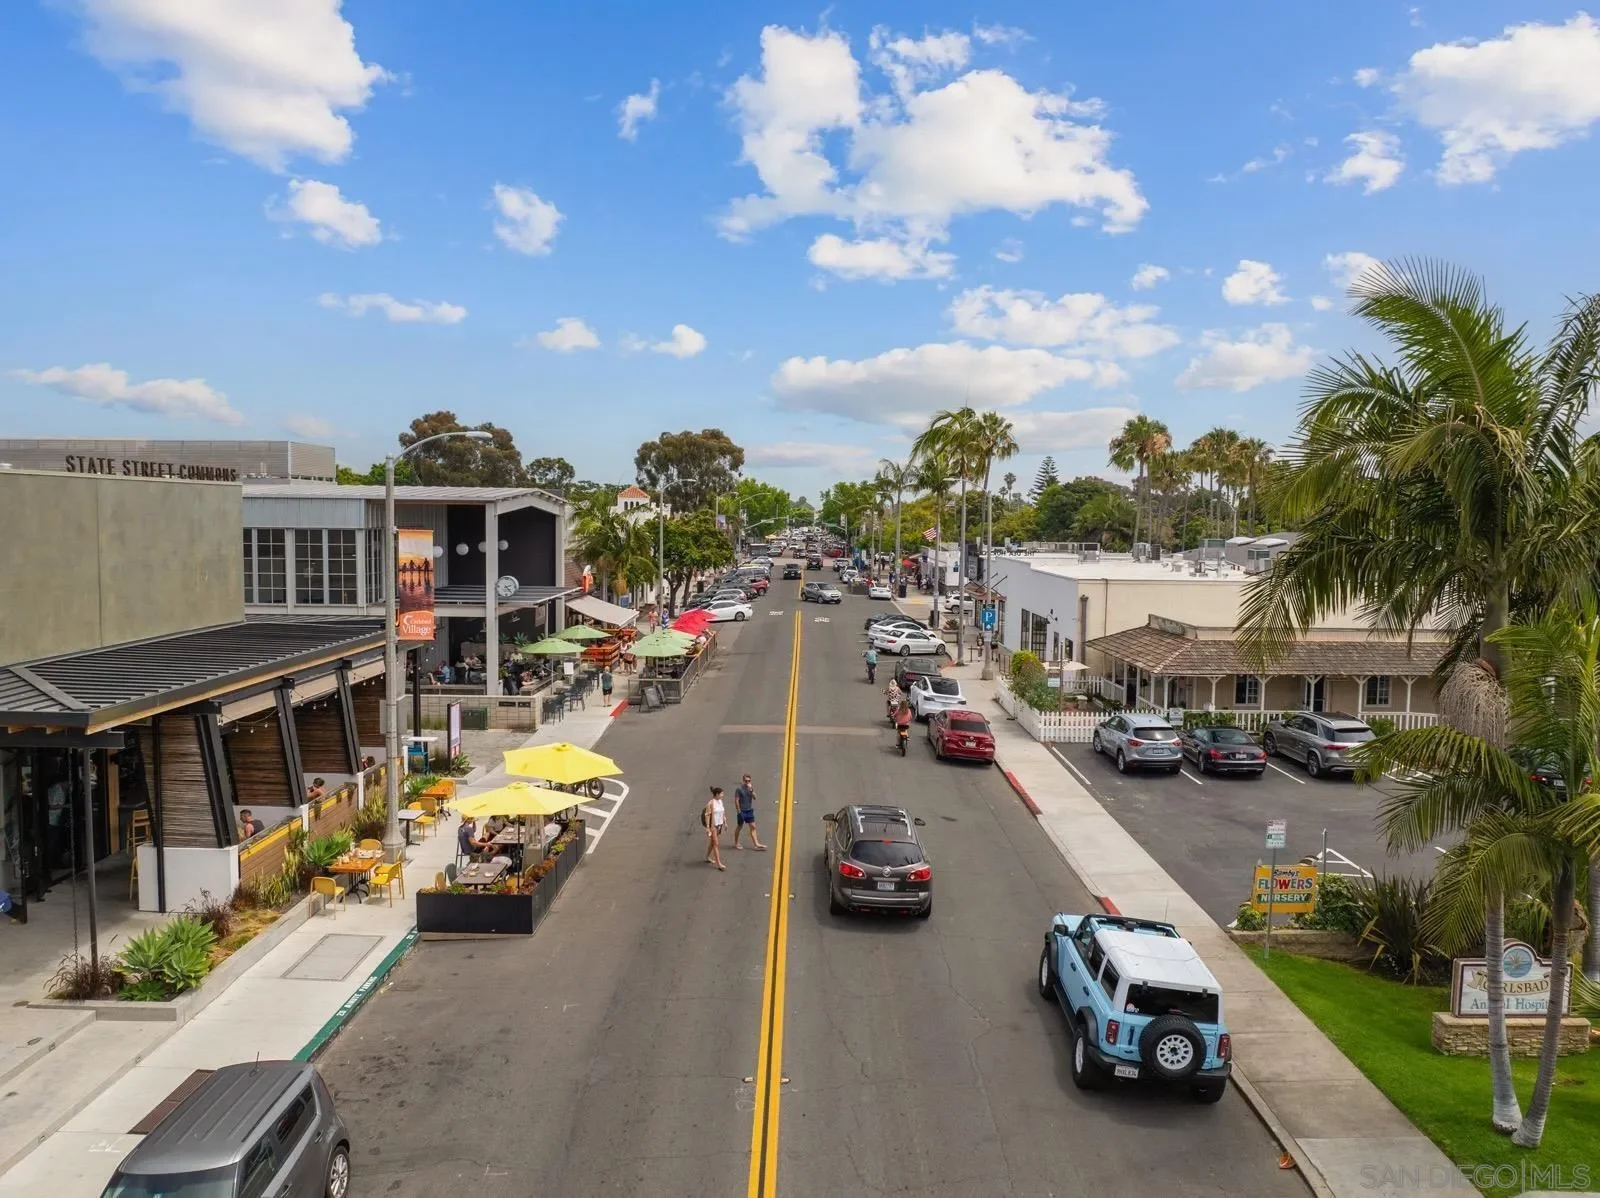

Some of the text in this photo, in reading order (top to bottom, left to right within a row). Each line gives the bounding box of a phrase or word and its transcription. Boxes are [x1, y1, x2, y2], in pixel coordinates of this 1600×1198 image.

[65, 455, 237, 482] STATE STREET COMMONS
[985, 611, 993, 622] P
[403, 624, 430, 635] Village
[1483, 980, 1549, 993] CRLSBAD
